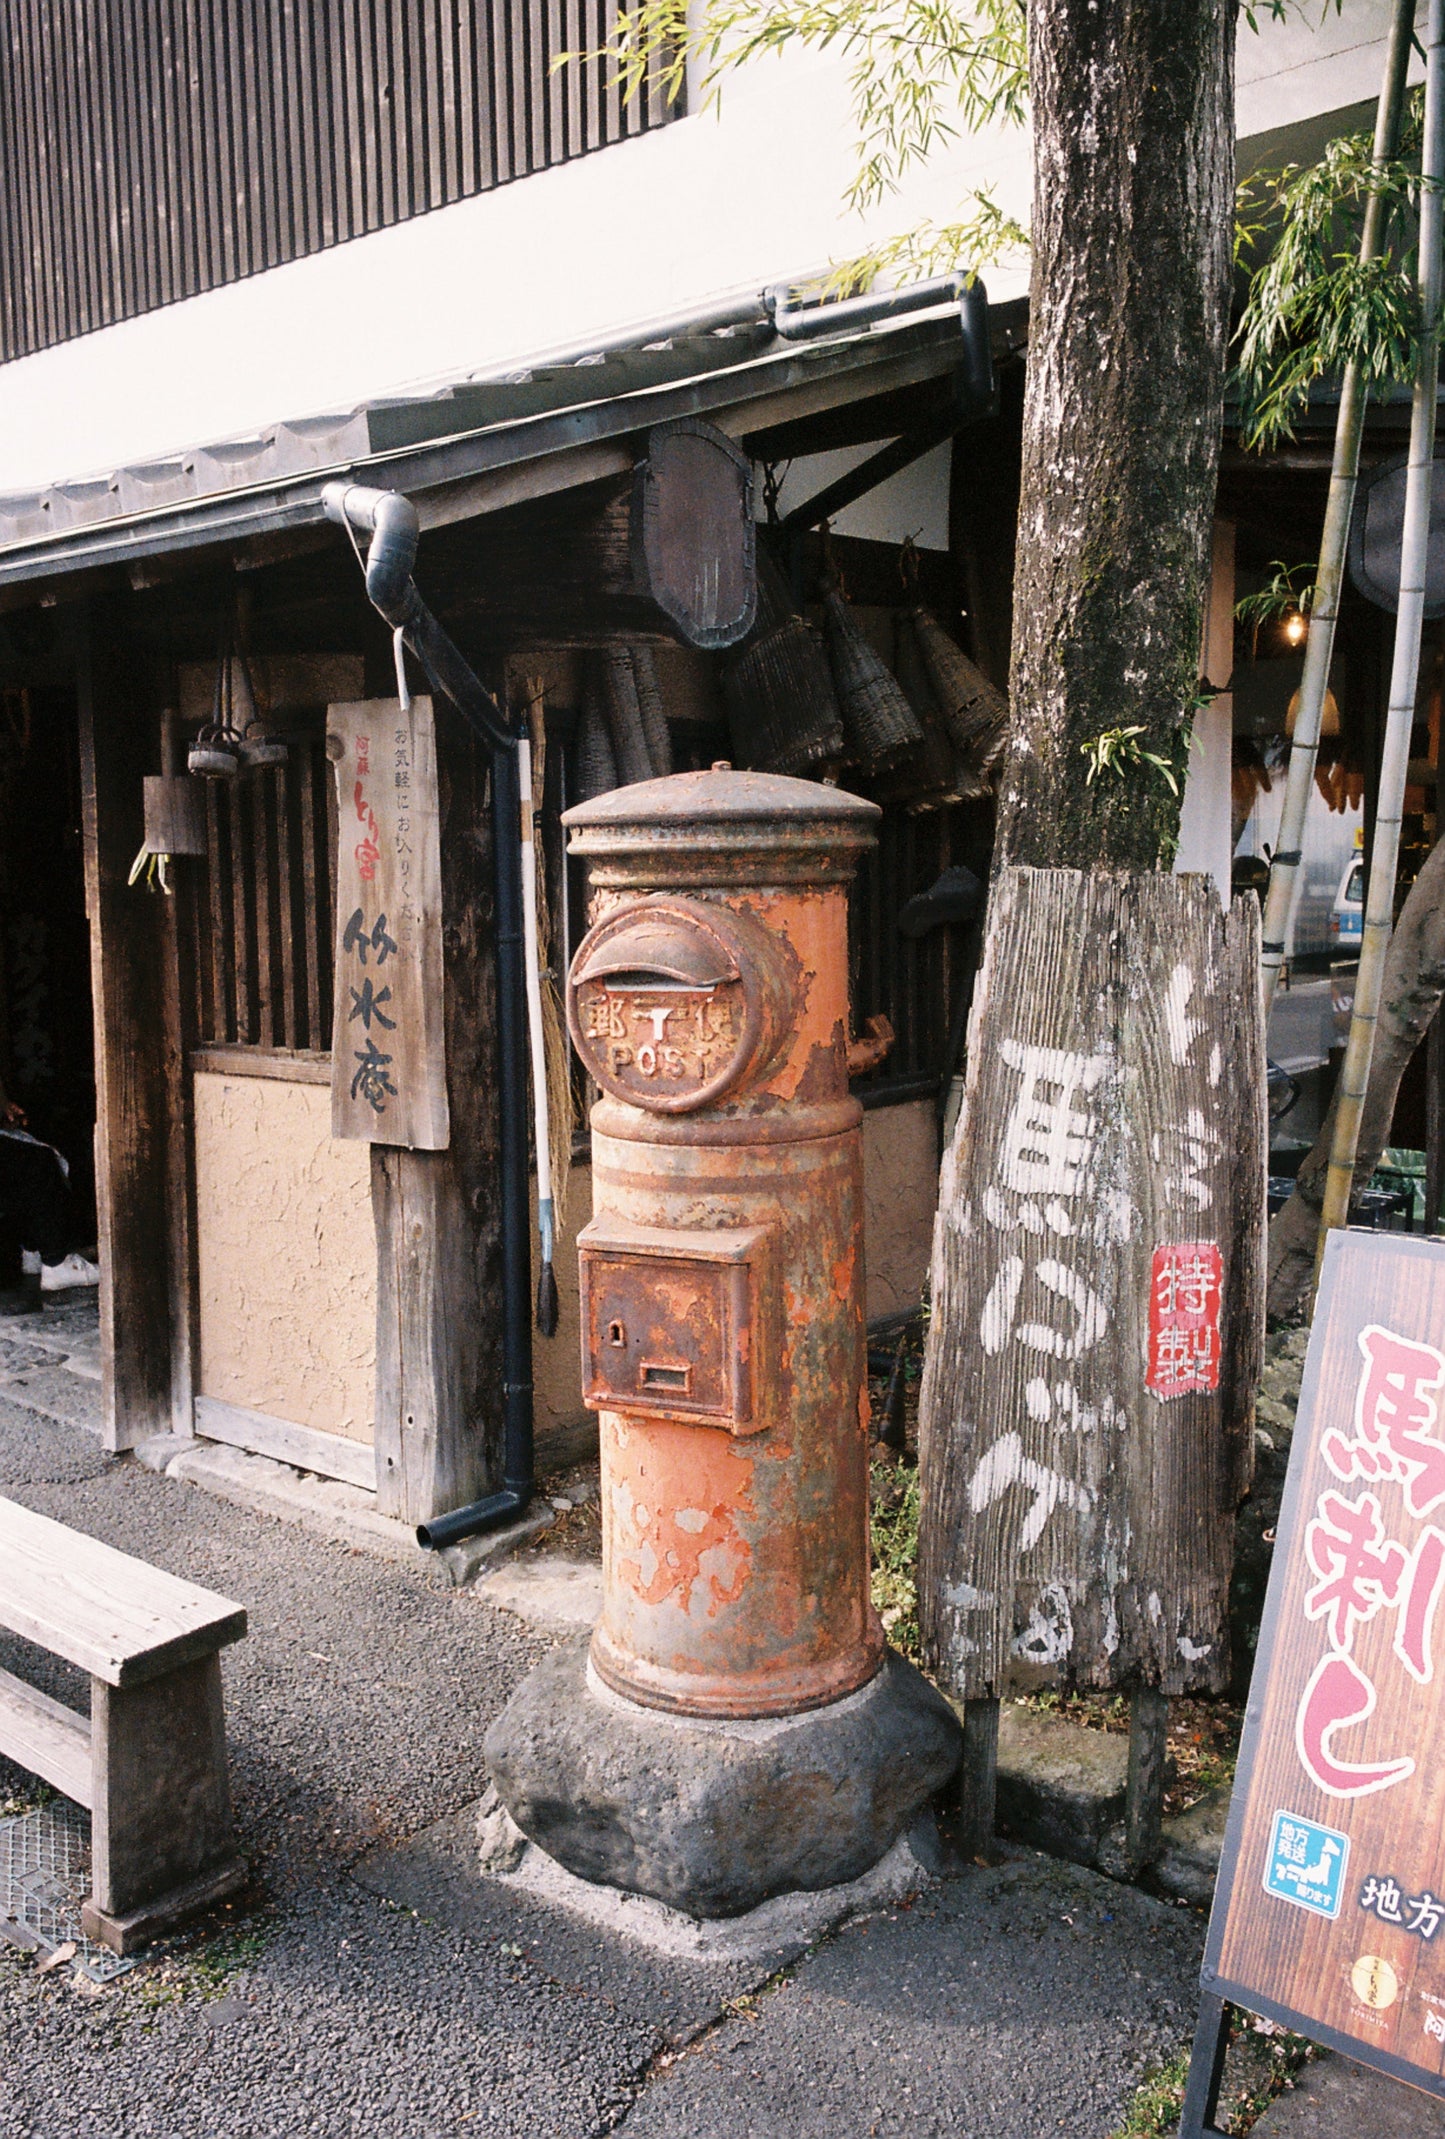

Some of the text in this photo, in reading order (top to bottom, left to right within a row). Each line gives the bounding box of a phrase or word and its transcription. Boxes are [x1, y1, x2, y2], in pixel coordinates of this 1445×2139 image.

[343, 907, 399, 1114] 竹水庵
[610, 1044, 712, 1080] POST
[1155, 1254, 1216, 1384] 特製
[1297, 1324, 1445, 1797] 馬刺し
[1279, 1820, 1310, 1847] 地方
[1361, 1878, 1445, 1938] 地方
